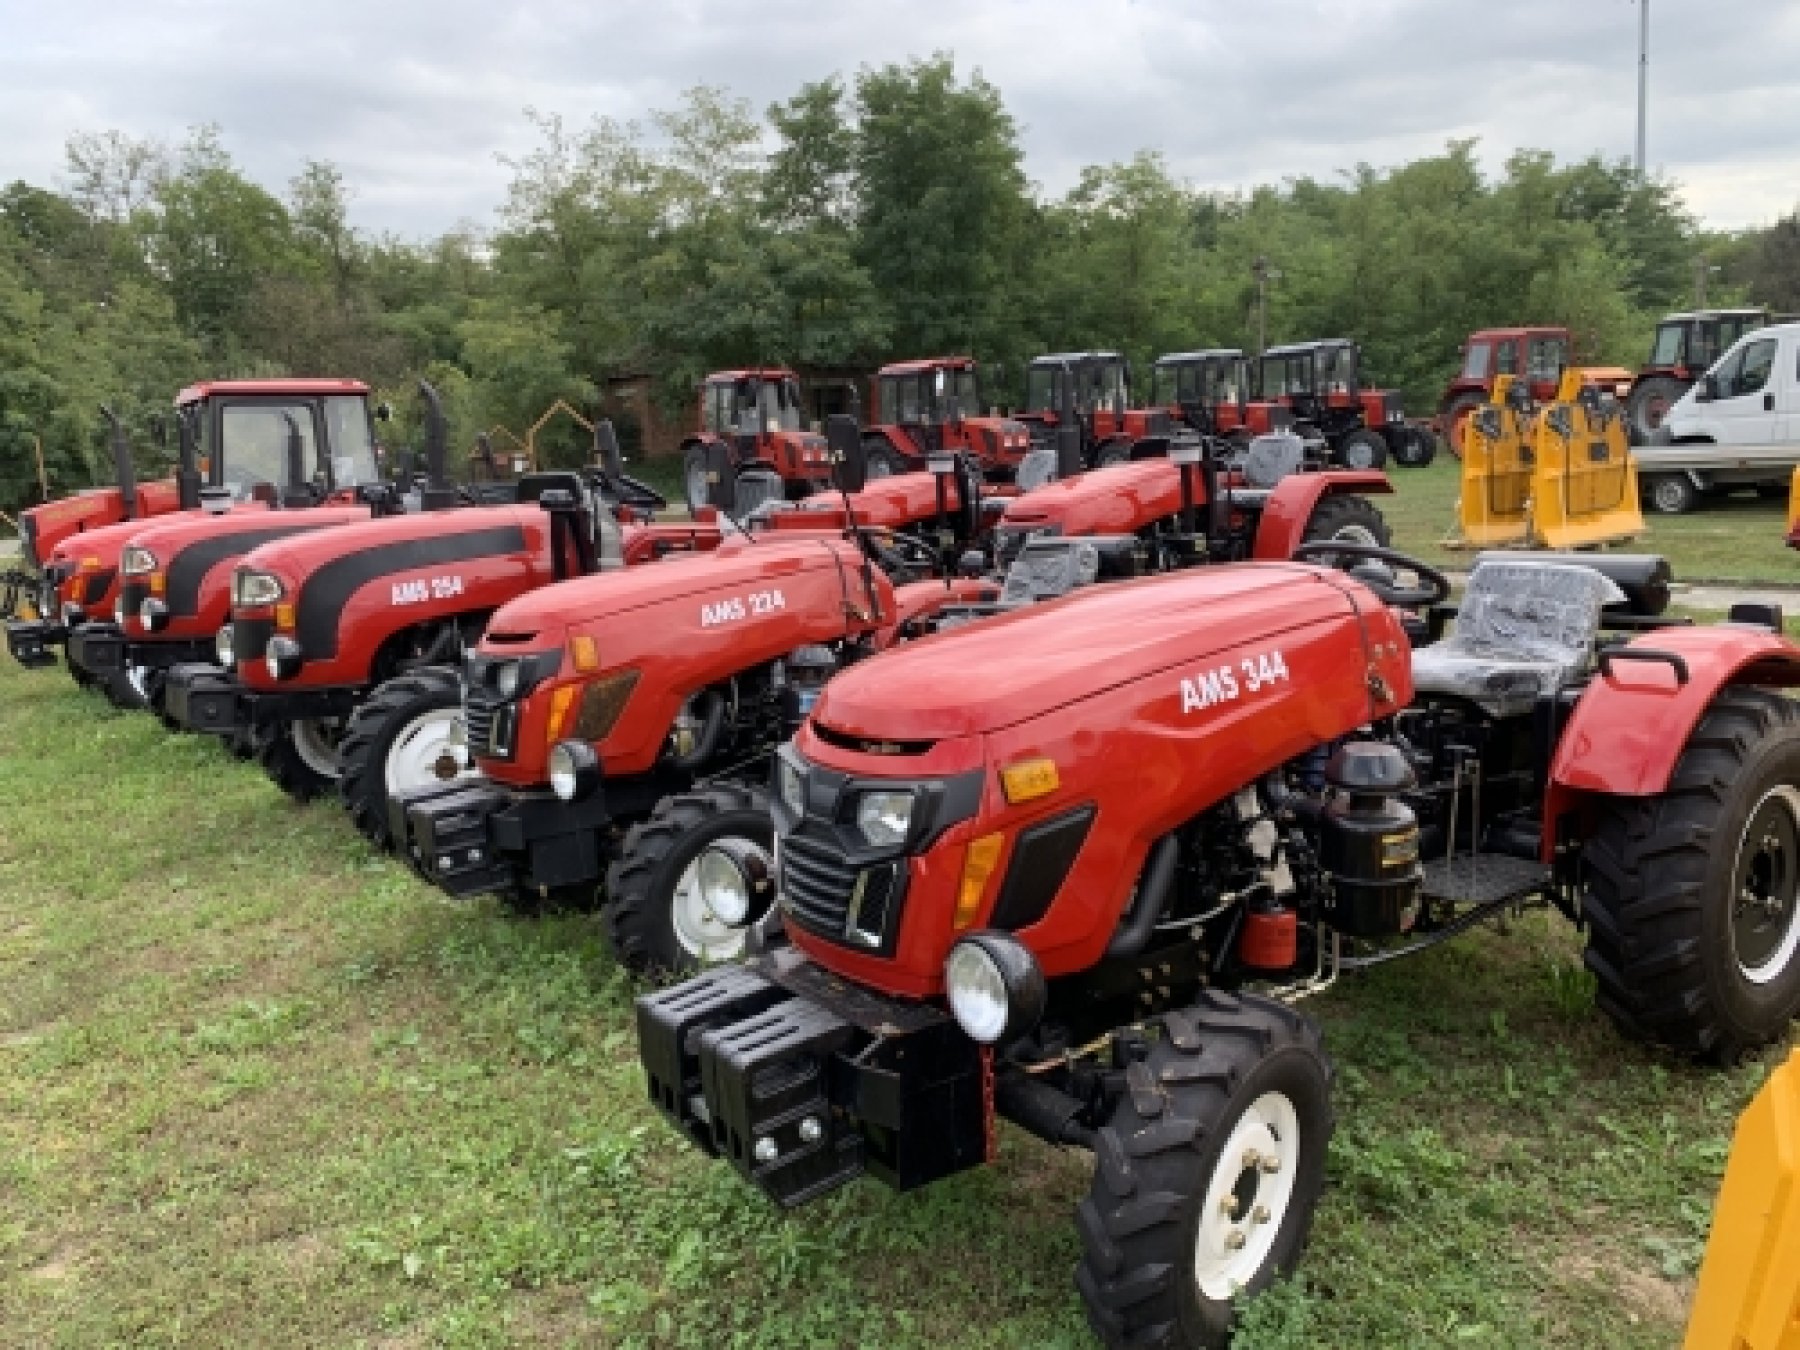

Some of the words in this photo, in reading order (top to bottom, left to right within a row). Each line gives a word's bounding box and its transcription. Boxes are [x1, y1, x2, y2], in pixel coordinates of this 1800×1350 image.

[701, 597, 745, 627] AMS
[1181, 666, 1239, 713] AMS
[1241, 650, 1290, 692] 344
